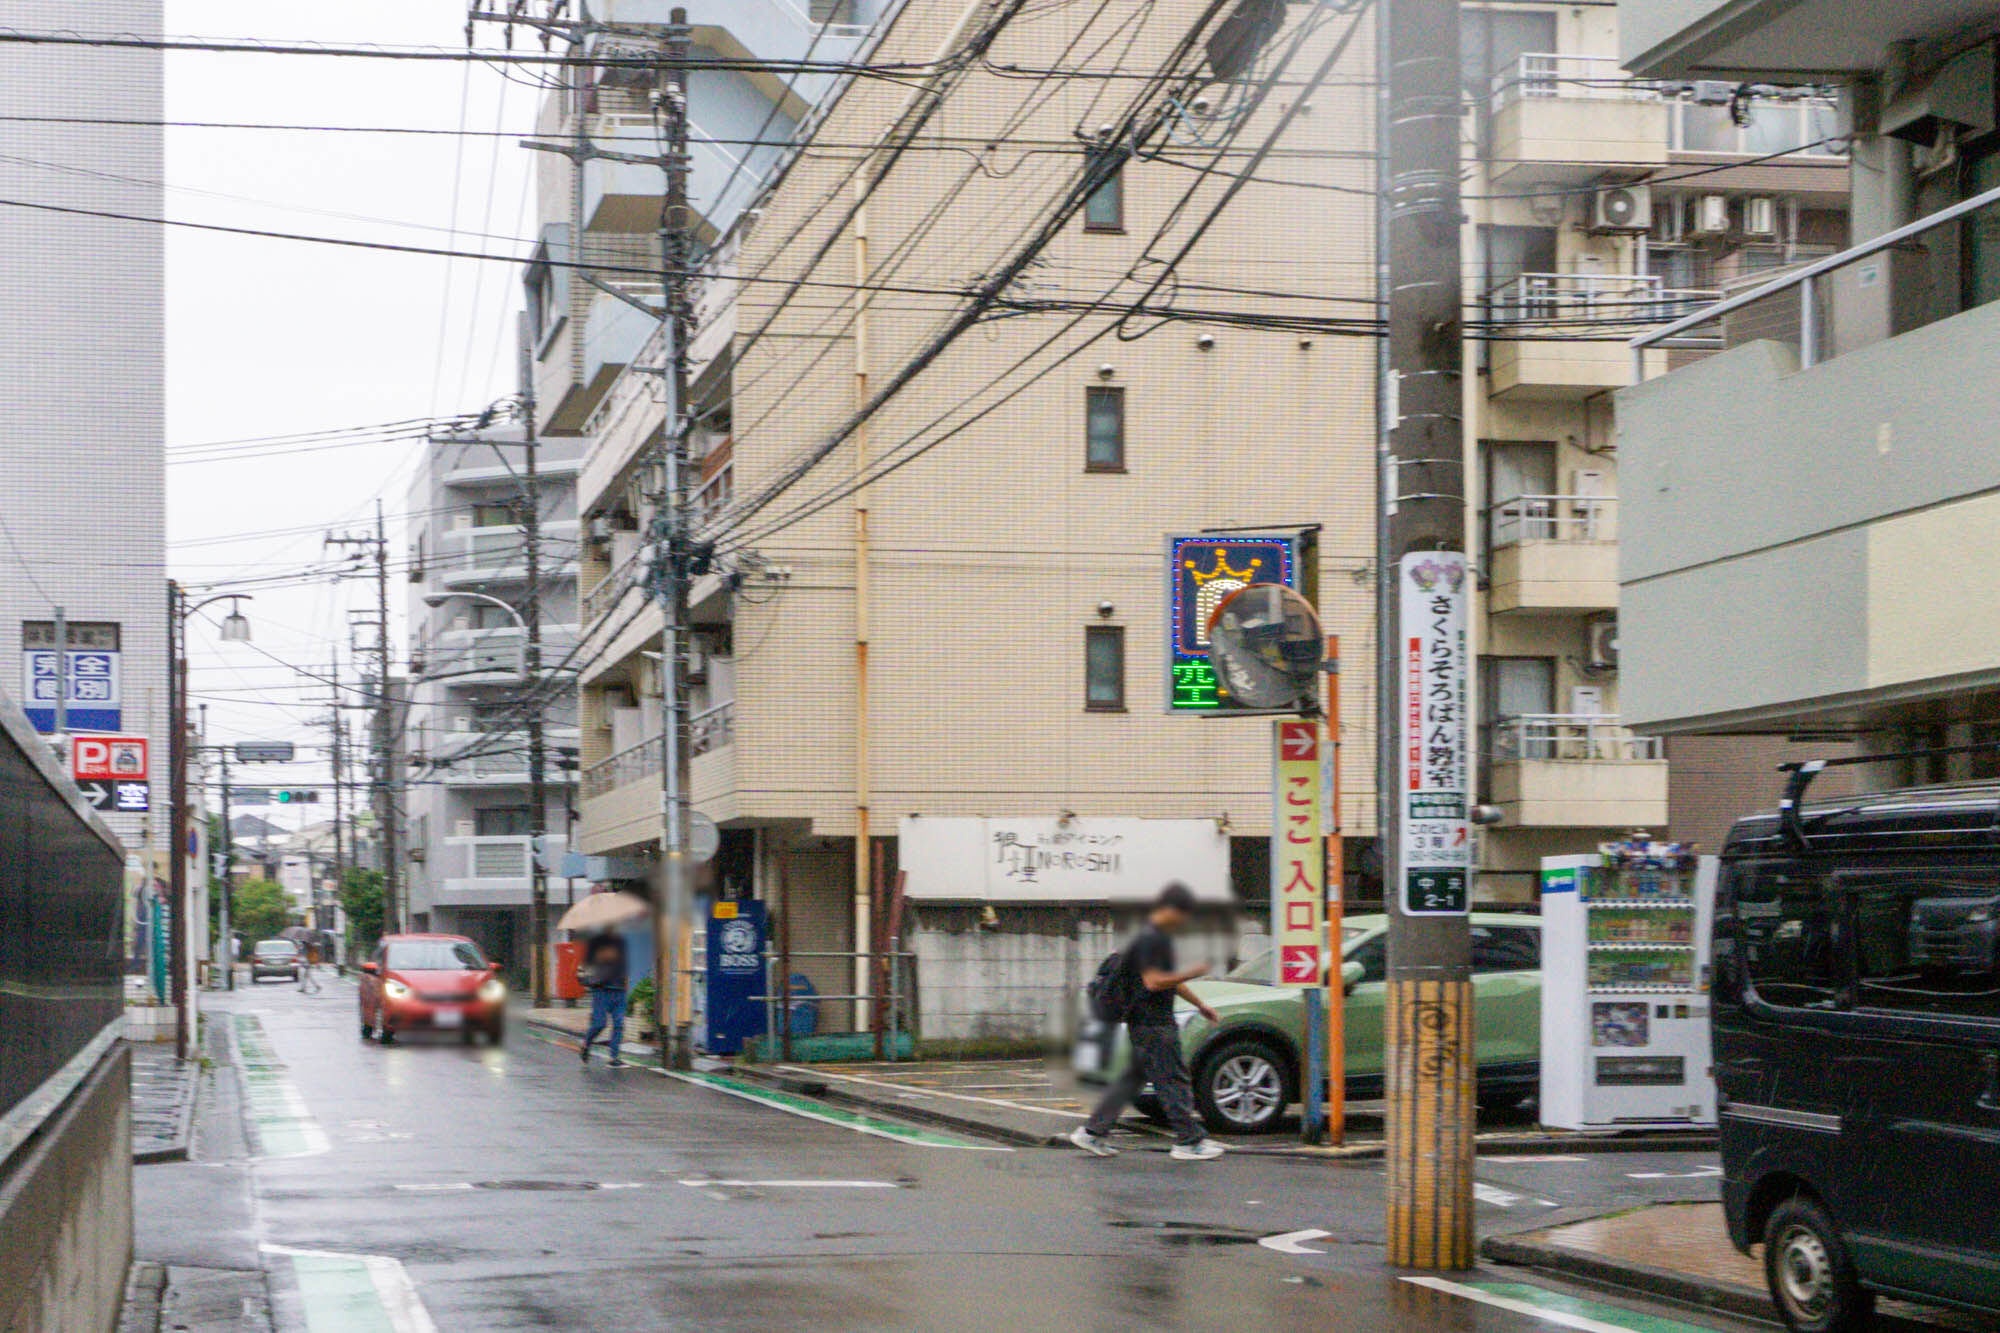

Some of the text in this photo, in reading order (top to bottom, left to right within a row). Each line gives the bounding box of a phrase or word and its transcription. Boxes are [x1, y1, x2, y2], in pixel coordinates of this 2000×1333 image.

[1427, 594, 1454, 788] さくらそろばん教室
[77, 741, 108, 773] P
[1038, 851, 1121, 873] NOROSHI
[1284, 776, 1315, 932] ここ入口
[1423, 894, 1455, 907] 2-1
